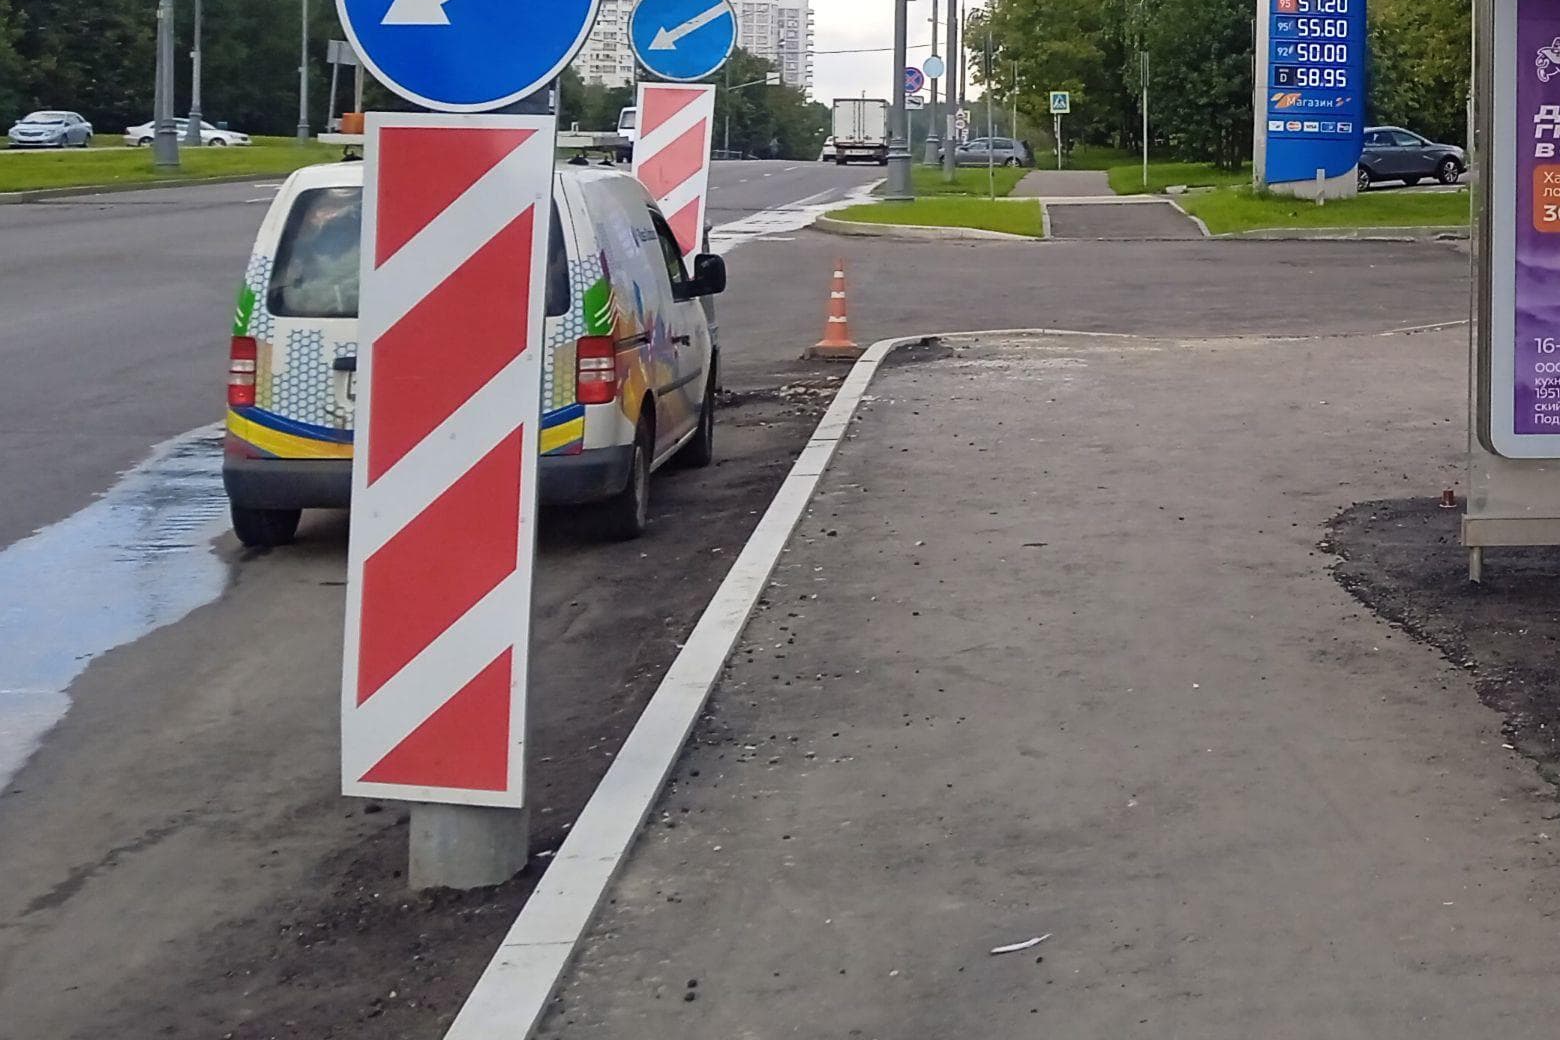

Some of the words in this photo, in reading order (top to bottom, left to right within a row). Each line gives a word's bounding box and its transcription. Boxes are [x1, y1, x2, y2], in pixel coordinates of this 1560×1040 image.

[1280, 0, 1290, 8] 95
[1278, 22, 1288, 31] 95
[1298, 18, 1347, 38] 55.60
[1277, 48, 1288, 56] 92
[1297, 44, 1347, 62] 50.00
[1296, 68, 1346, 88] 58.95
[1287, 96, 1333, 108] Магазин
[1534, 142, 1554, 158] В
